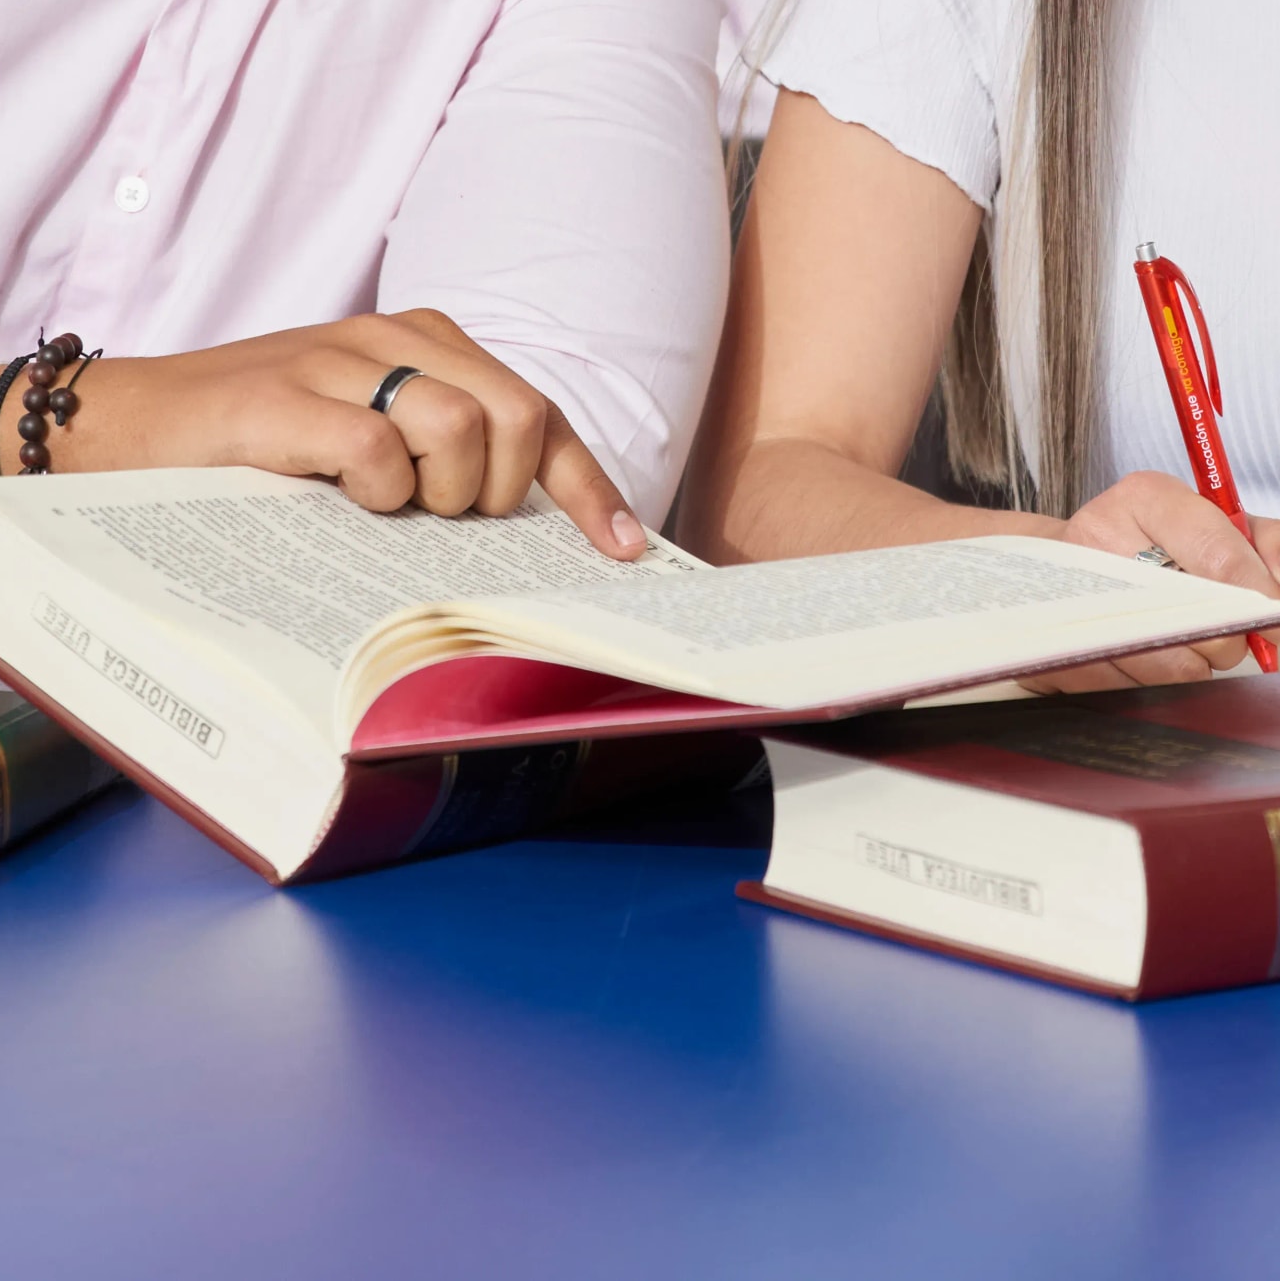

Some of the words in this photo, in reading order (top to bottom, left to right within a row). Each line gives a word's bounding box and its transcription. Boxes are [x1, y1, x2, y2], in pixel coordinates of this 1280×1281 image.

[1169, 330, 1189, 376] contigo
[1183, 378, 1194, 395] va
[1188, 395, 1204, 421] que
[1195, 422, 1221, 490] Educación
[103, 648, 212, 745] BIBLIOTECA
